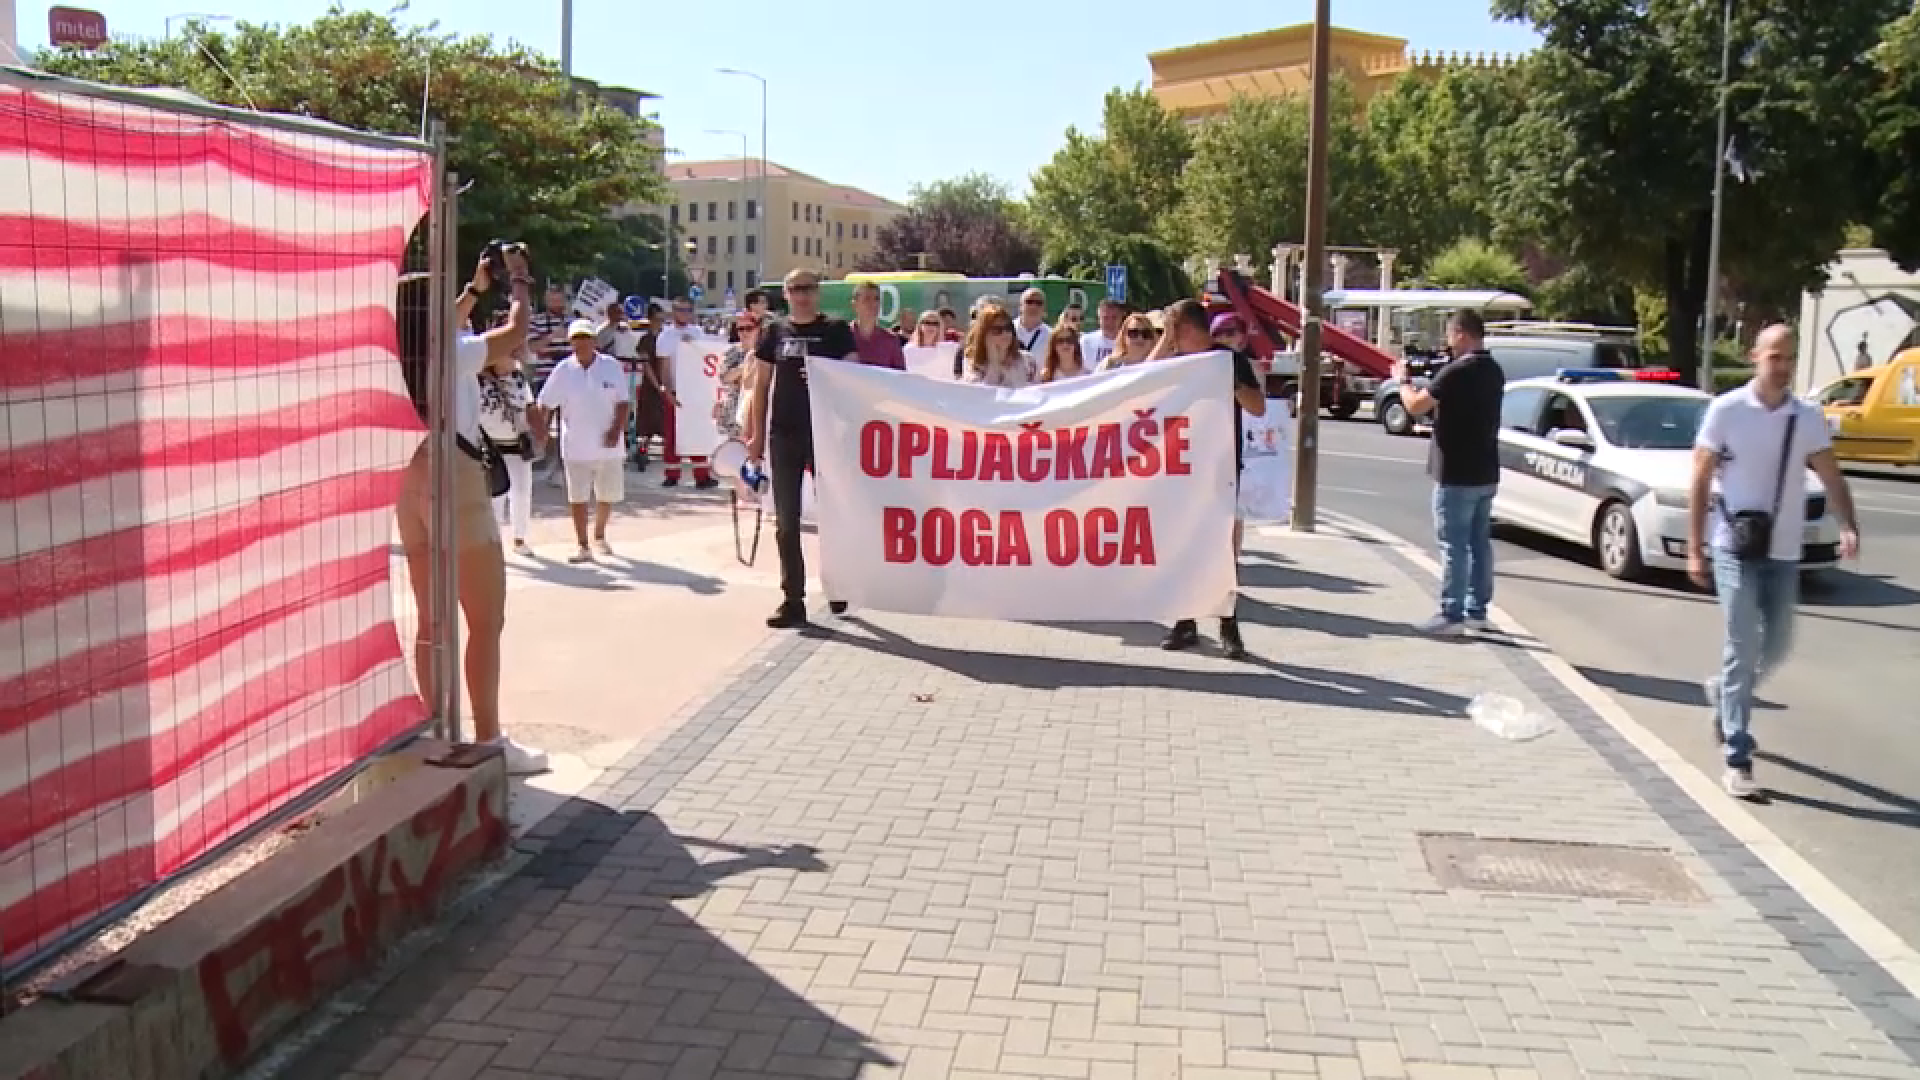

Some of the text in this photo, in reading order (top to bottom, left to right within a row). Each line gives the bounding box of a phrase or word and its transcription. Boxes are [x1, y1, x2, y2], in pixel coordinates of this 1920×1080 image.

[860, 408, 1192, 482] OPLJAČKAŠE
[883, 506, 1156, 567] BOGA OCA
